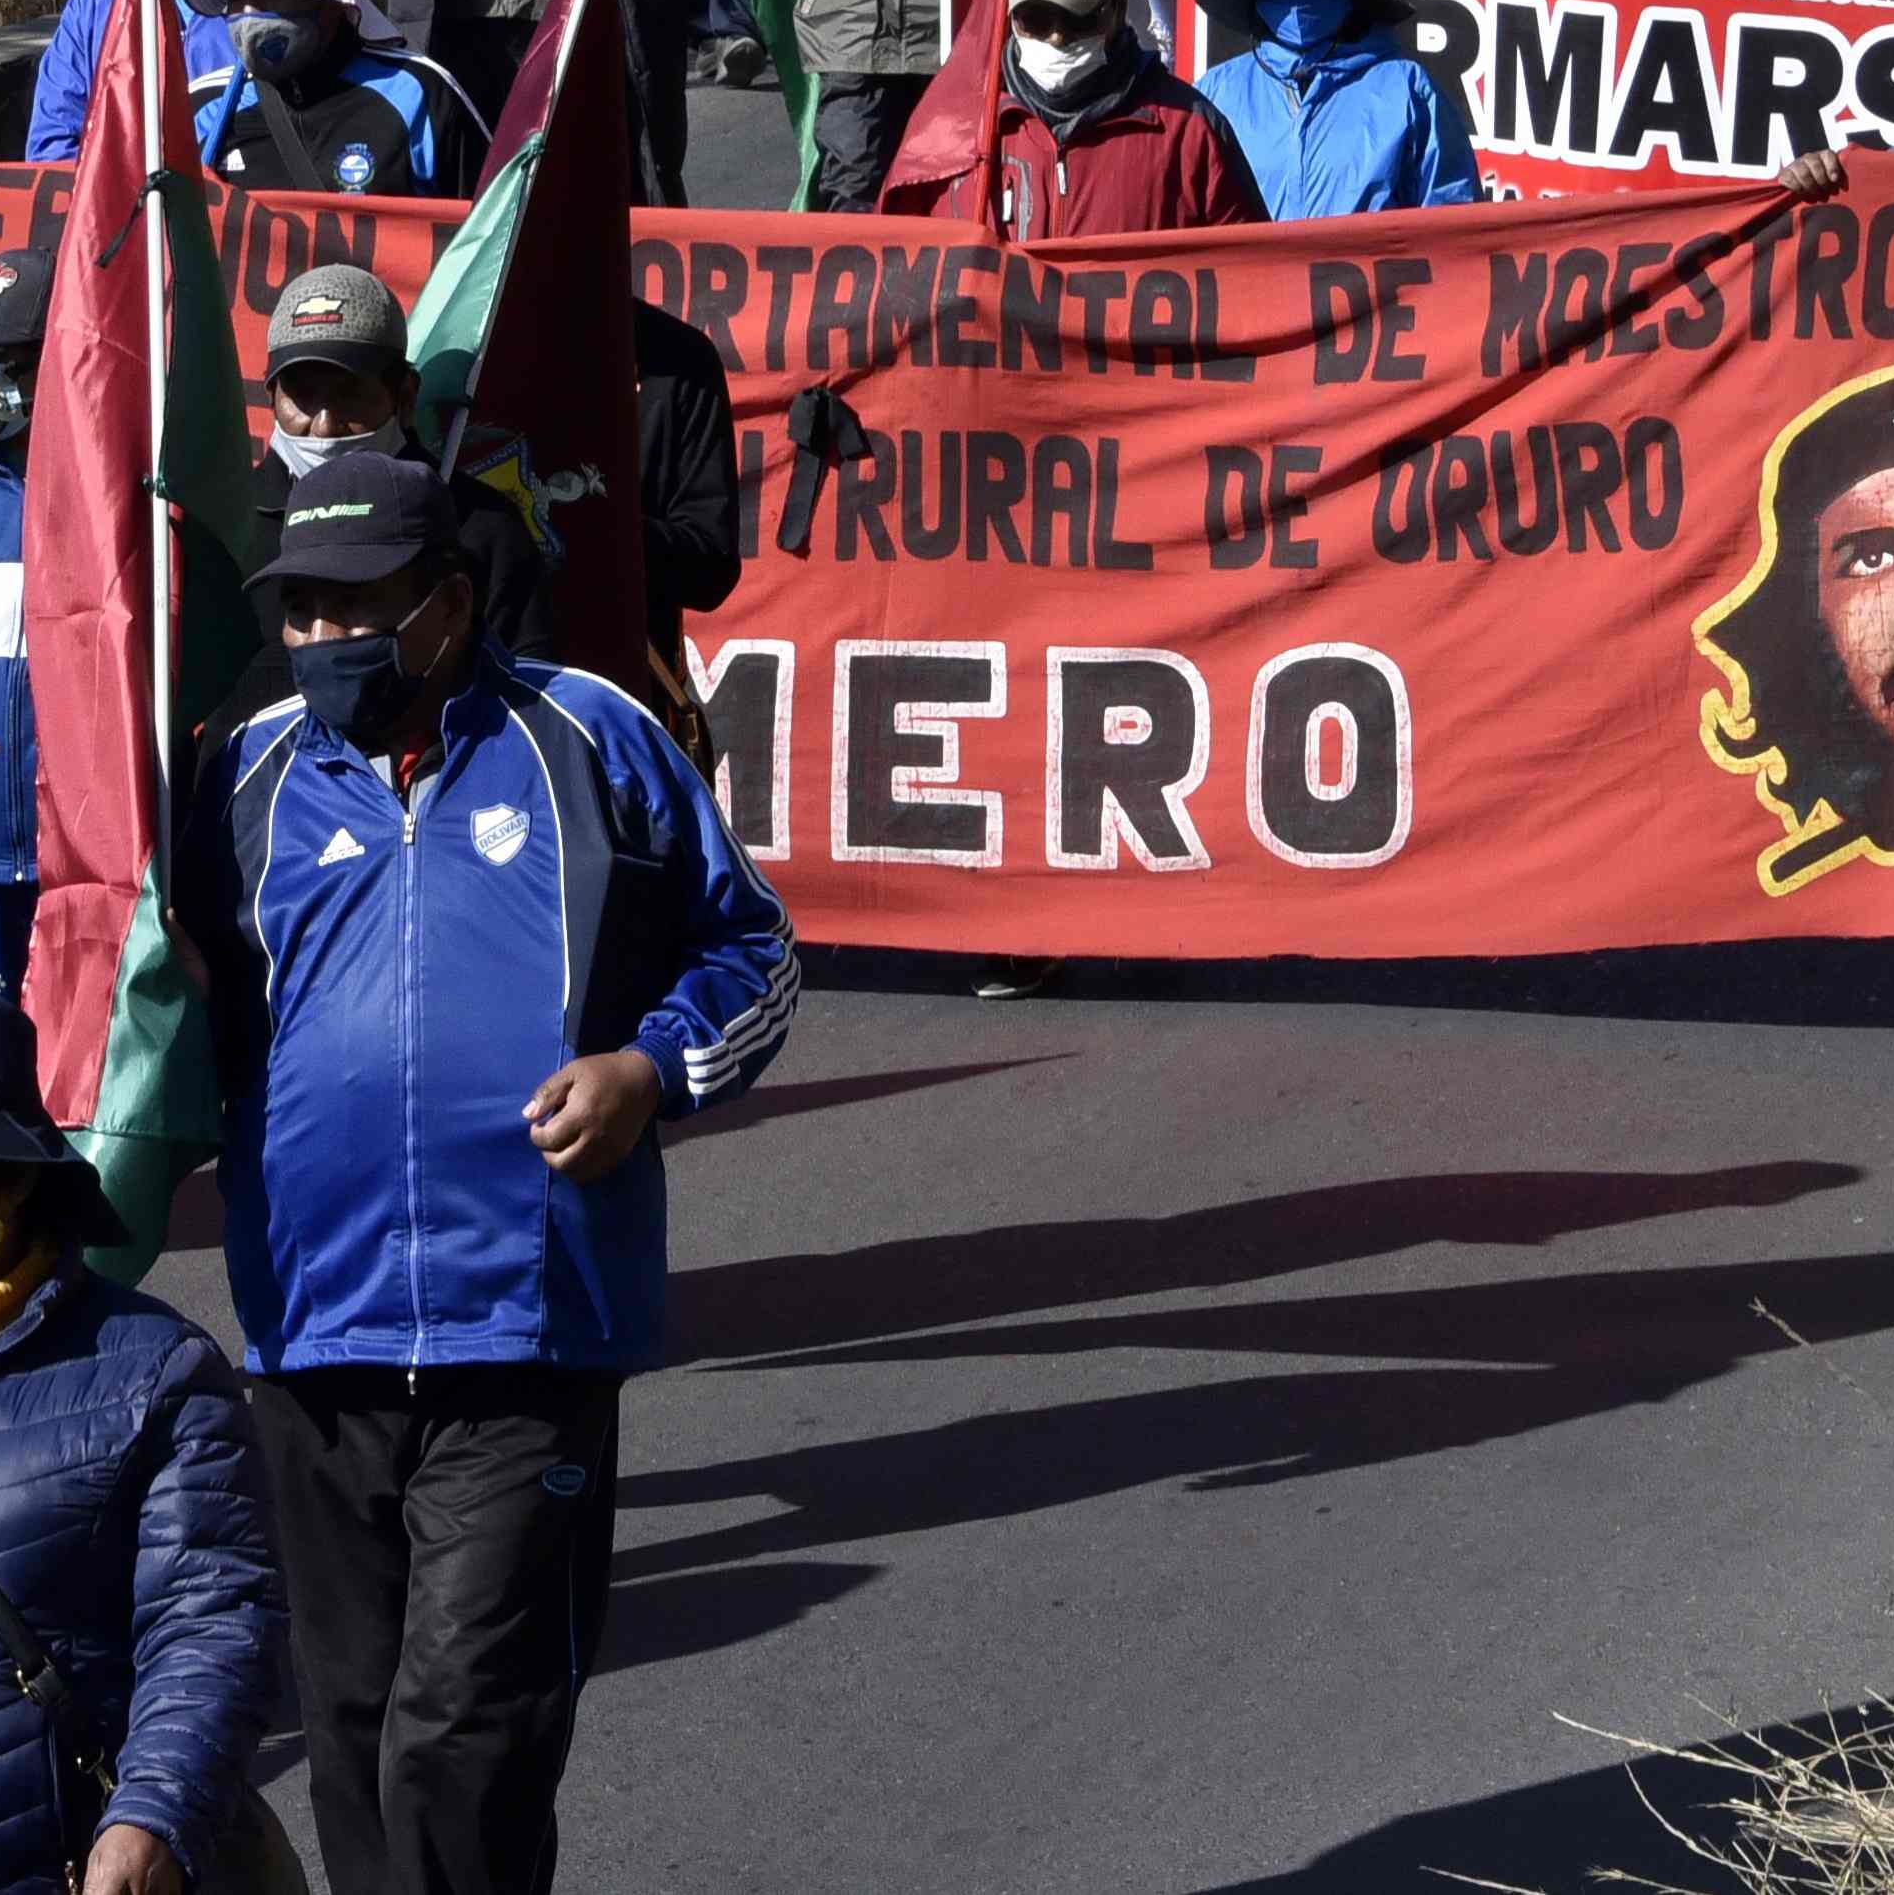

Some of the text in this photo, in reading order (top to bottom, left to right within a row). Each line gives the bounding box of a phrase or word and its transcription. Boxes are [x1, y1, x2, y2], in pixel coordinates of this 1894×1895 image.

[1309, 257, 1434, 387] DE
[833, 427, 1154, 572] RURAL
[1203, 443, 1325, 571] DE
[1370, 415, 1685, 566] ORURO
[681, 637, 1414, 875] MERO
